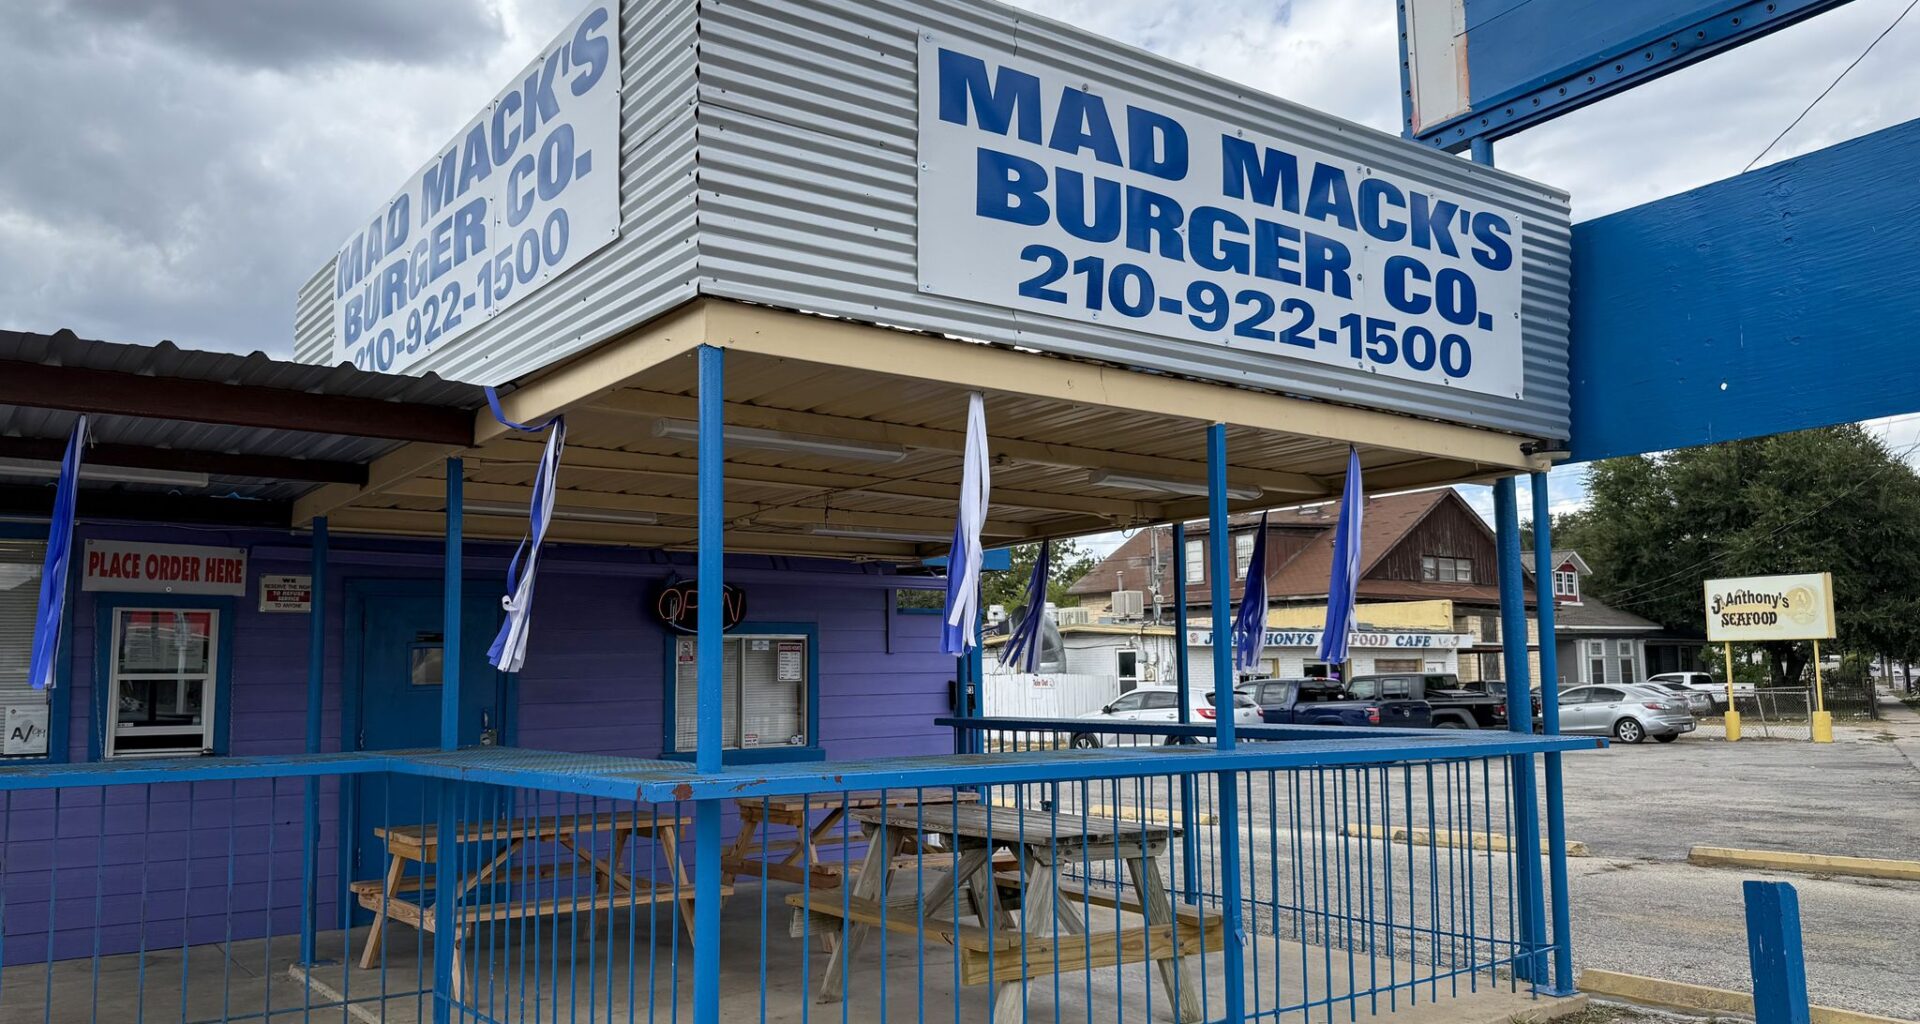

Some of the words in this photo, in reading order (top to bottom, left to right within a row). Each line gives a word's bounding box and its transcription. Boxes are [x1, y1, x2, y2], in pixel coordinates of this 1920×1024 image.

[337, 193, 410, 299] MAD
[421, 7, 609, 229] MACK'S
[938, 47, 1189, 182] MAD
[1221, 134, 1513, 272] MACK'S
[344, 197, 488, 349] BURGER
[506, 123, 592, 228] CO.
[975, 147, 1353, 301] BURGER
[1384, 255, 1493, 332] CO.
[1018, 245, 1472, 379] 210-922-1500
[88, 551, 141, 579] PLACE
[145, 554, 200, 582] ORDER
[205, 557, 243, 584] HERE
[659, 589, 742, 622] OPN
[1725, 590, 1790, 609] Anthony's
[1395, 635, 1432, 647] CAFE
[1721, 611, 1778, 628] SEAFOOD
